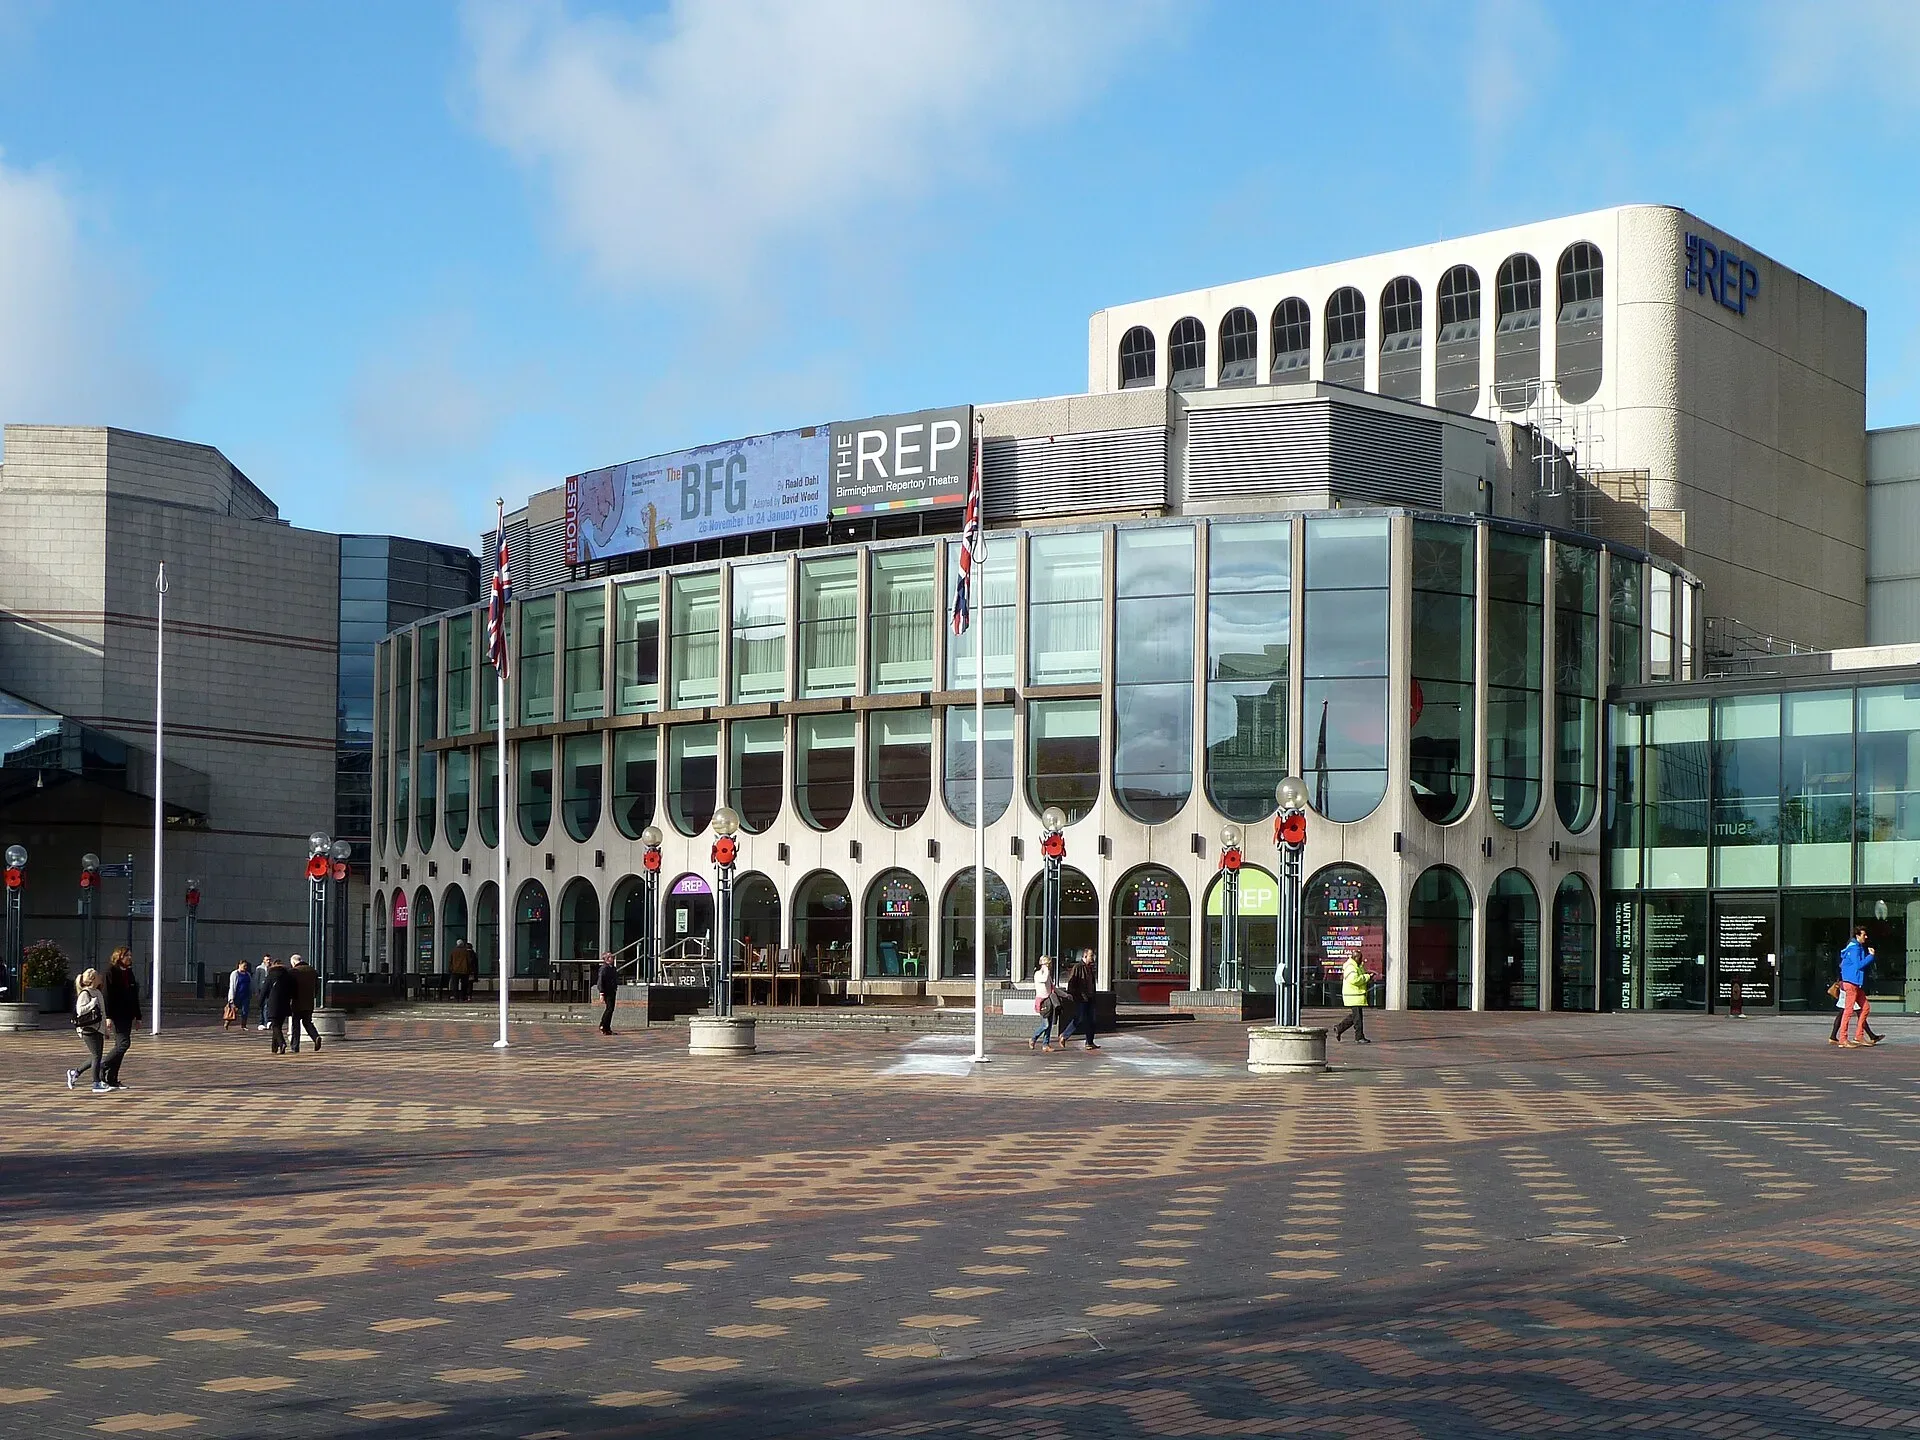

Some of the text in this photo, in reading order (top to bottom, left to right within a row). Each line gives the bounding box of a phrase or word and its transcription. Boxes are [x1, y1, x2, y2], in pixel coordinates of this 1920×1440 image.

[1698, 238, 1760, 316] REP
[836, 432, 852, 483] THE
[856, 420, 962, 481] REP
[666, 467, 681, 482] The
[785, 477, 803, 489] Roald
[804, 475, 820, 487] Dahl
[680, 453, 747, 520] BFG
[836, 475, 960, 497] Birmingham Repertory Theatre
[781, 493, 799, 505] David
[800, 490, 820, 502] Wood
[566, 480, 577, 553] HOUSE
[708, 515, 744, 532] November
[746, 514, 754, 526] to
[756, 512, 765, 524] 24
[767, 507, 798, 523] January
[799, 504, 819, 518] 2015
[684, 879, 703, 892] REP
[1138, 886, 1167, 900] REP
[1329, 885, 1360, 899] REP
[1621, 902, 1631, 1009] WRITTEN AND READ
[681, 975, 696, 986] REP
